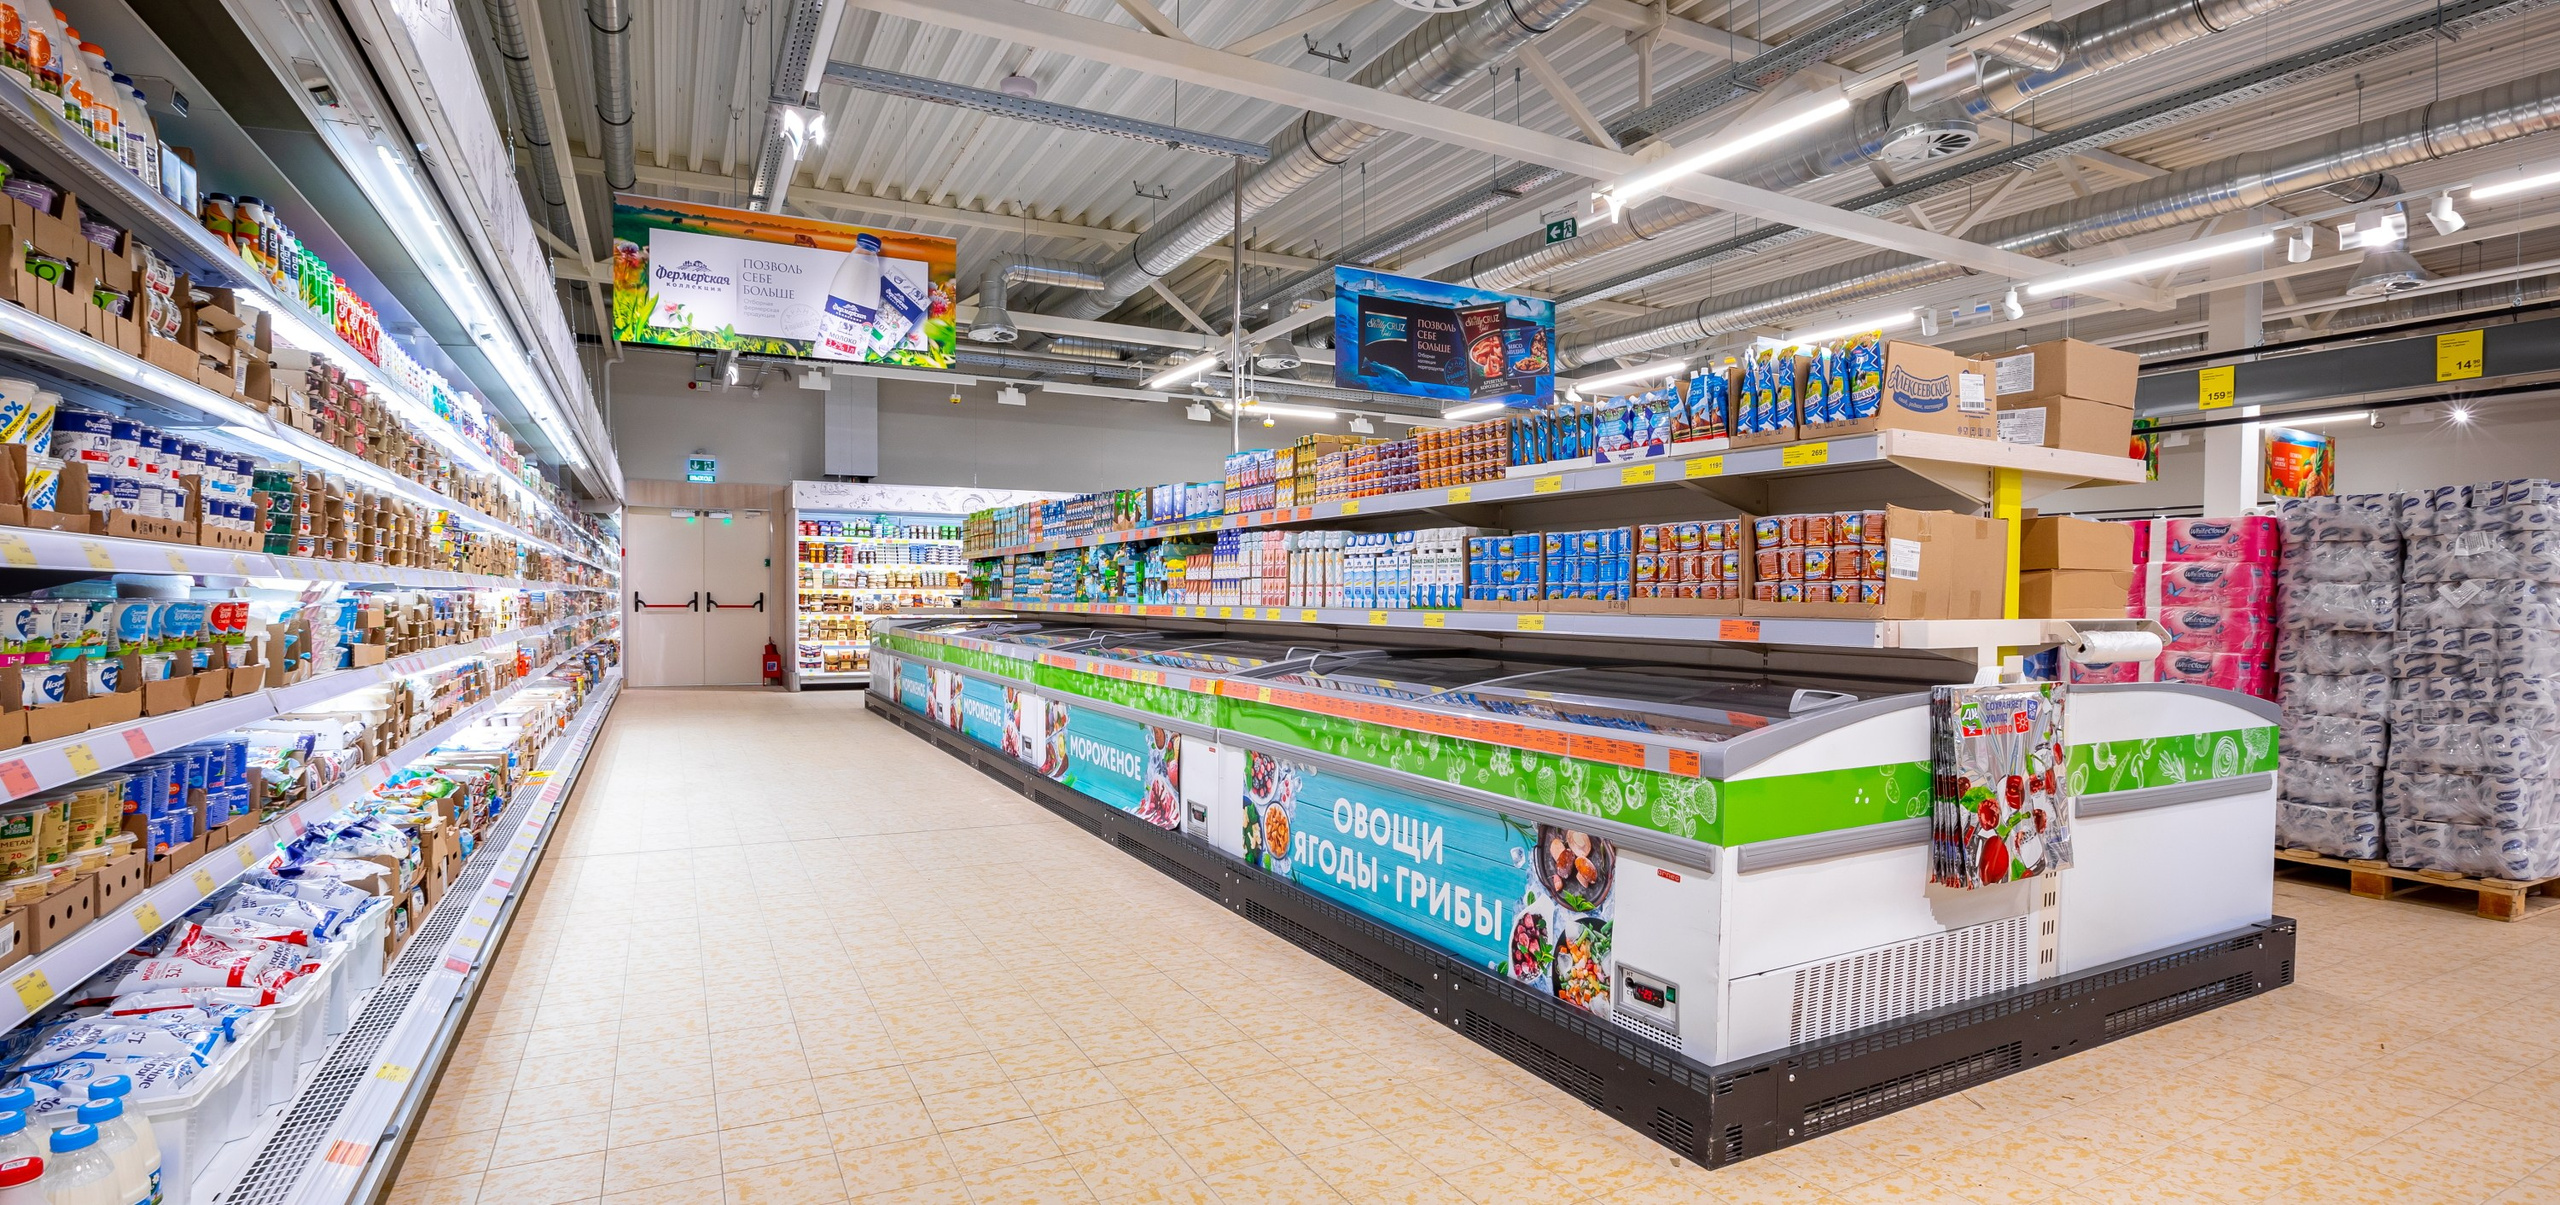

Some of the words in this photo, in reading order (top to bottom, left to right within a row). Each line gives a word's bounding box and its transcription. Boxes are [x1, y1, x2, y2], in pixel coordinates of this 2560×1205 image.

[743, 258, 803, 275] ПОЗВОЛЬ
[656, 265, 731, 286] Фермерская
[743, 271, 772, 284] СЕБЕ
[666, 282, 722, 292] коллекция
[743, 285, 795, 299] БОЛЬШЕ
[1417, 319, 1457, 332] ПОЗВОЛЬ
[1417, 330, 1437, 340] СЕБЕ
[1417, 341, 1451, 353] БОЛЬШЕ
[2456, 360, 2472, 370] 14
[2208, 392, 2226, 401] 159
[2190, 526, 2227, 536] WhiteCloud
[1985, 700, 2022, 711] СОХРАНЯЕТ
[963, 697, 1002, 727] МОРОЖЕНОЕ
[1985, 713, 2008, 724] ХОЛОД
[1994, 724, 2013, 735] ТЕПЛО
[1070, 734, 1142, 781] МОРОЖЕНОЕ
[1333, 797, 1444, 866] ОВОЩИ
[1294, 831, 1378, 893] ЯГОДЫ
[1396, 865, 1502, 941] ГРИБЫ
